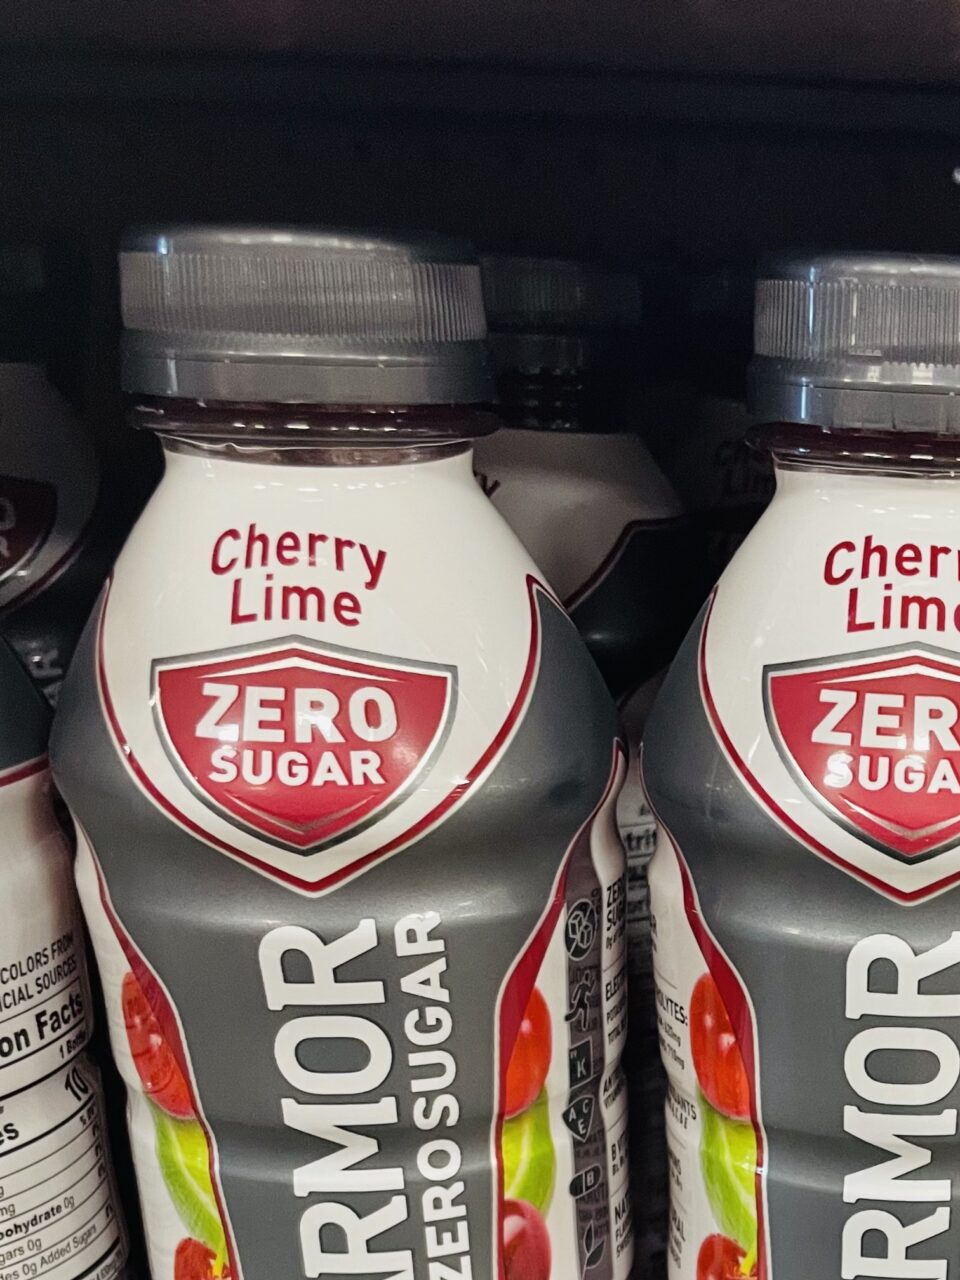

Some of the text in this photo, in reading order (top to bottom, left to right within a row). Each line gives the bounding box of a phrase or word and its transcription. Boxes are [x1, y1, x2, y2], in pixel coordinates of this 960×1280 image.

[210, 522, 388, 592] Cherry
[229, 577, 362, 628] Lime
[195, 682, 398, 744] ZERO
[208, 748, 385, 787] SUGAR
[35, 954, 78, 995] SOURCES
[35, 990, 84, 1041] Facts
[395, 911, 460, 1130] SUGAR
[65, 1066, 89, 1101] 10
[40, 1246, 72, 1269] Added
